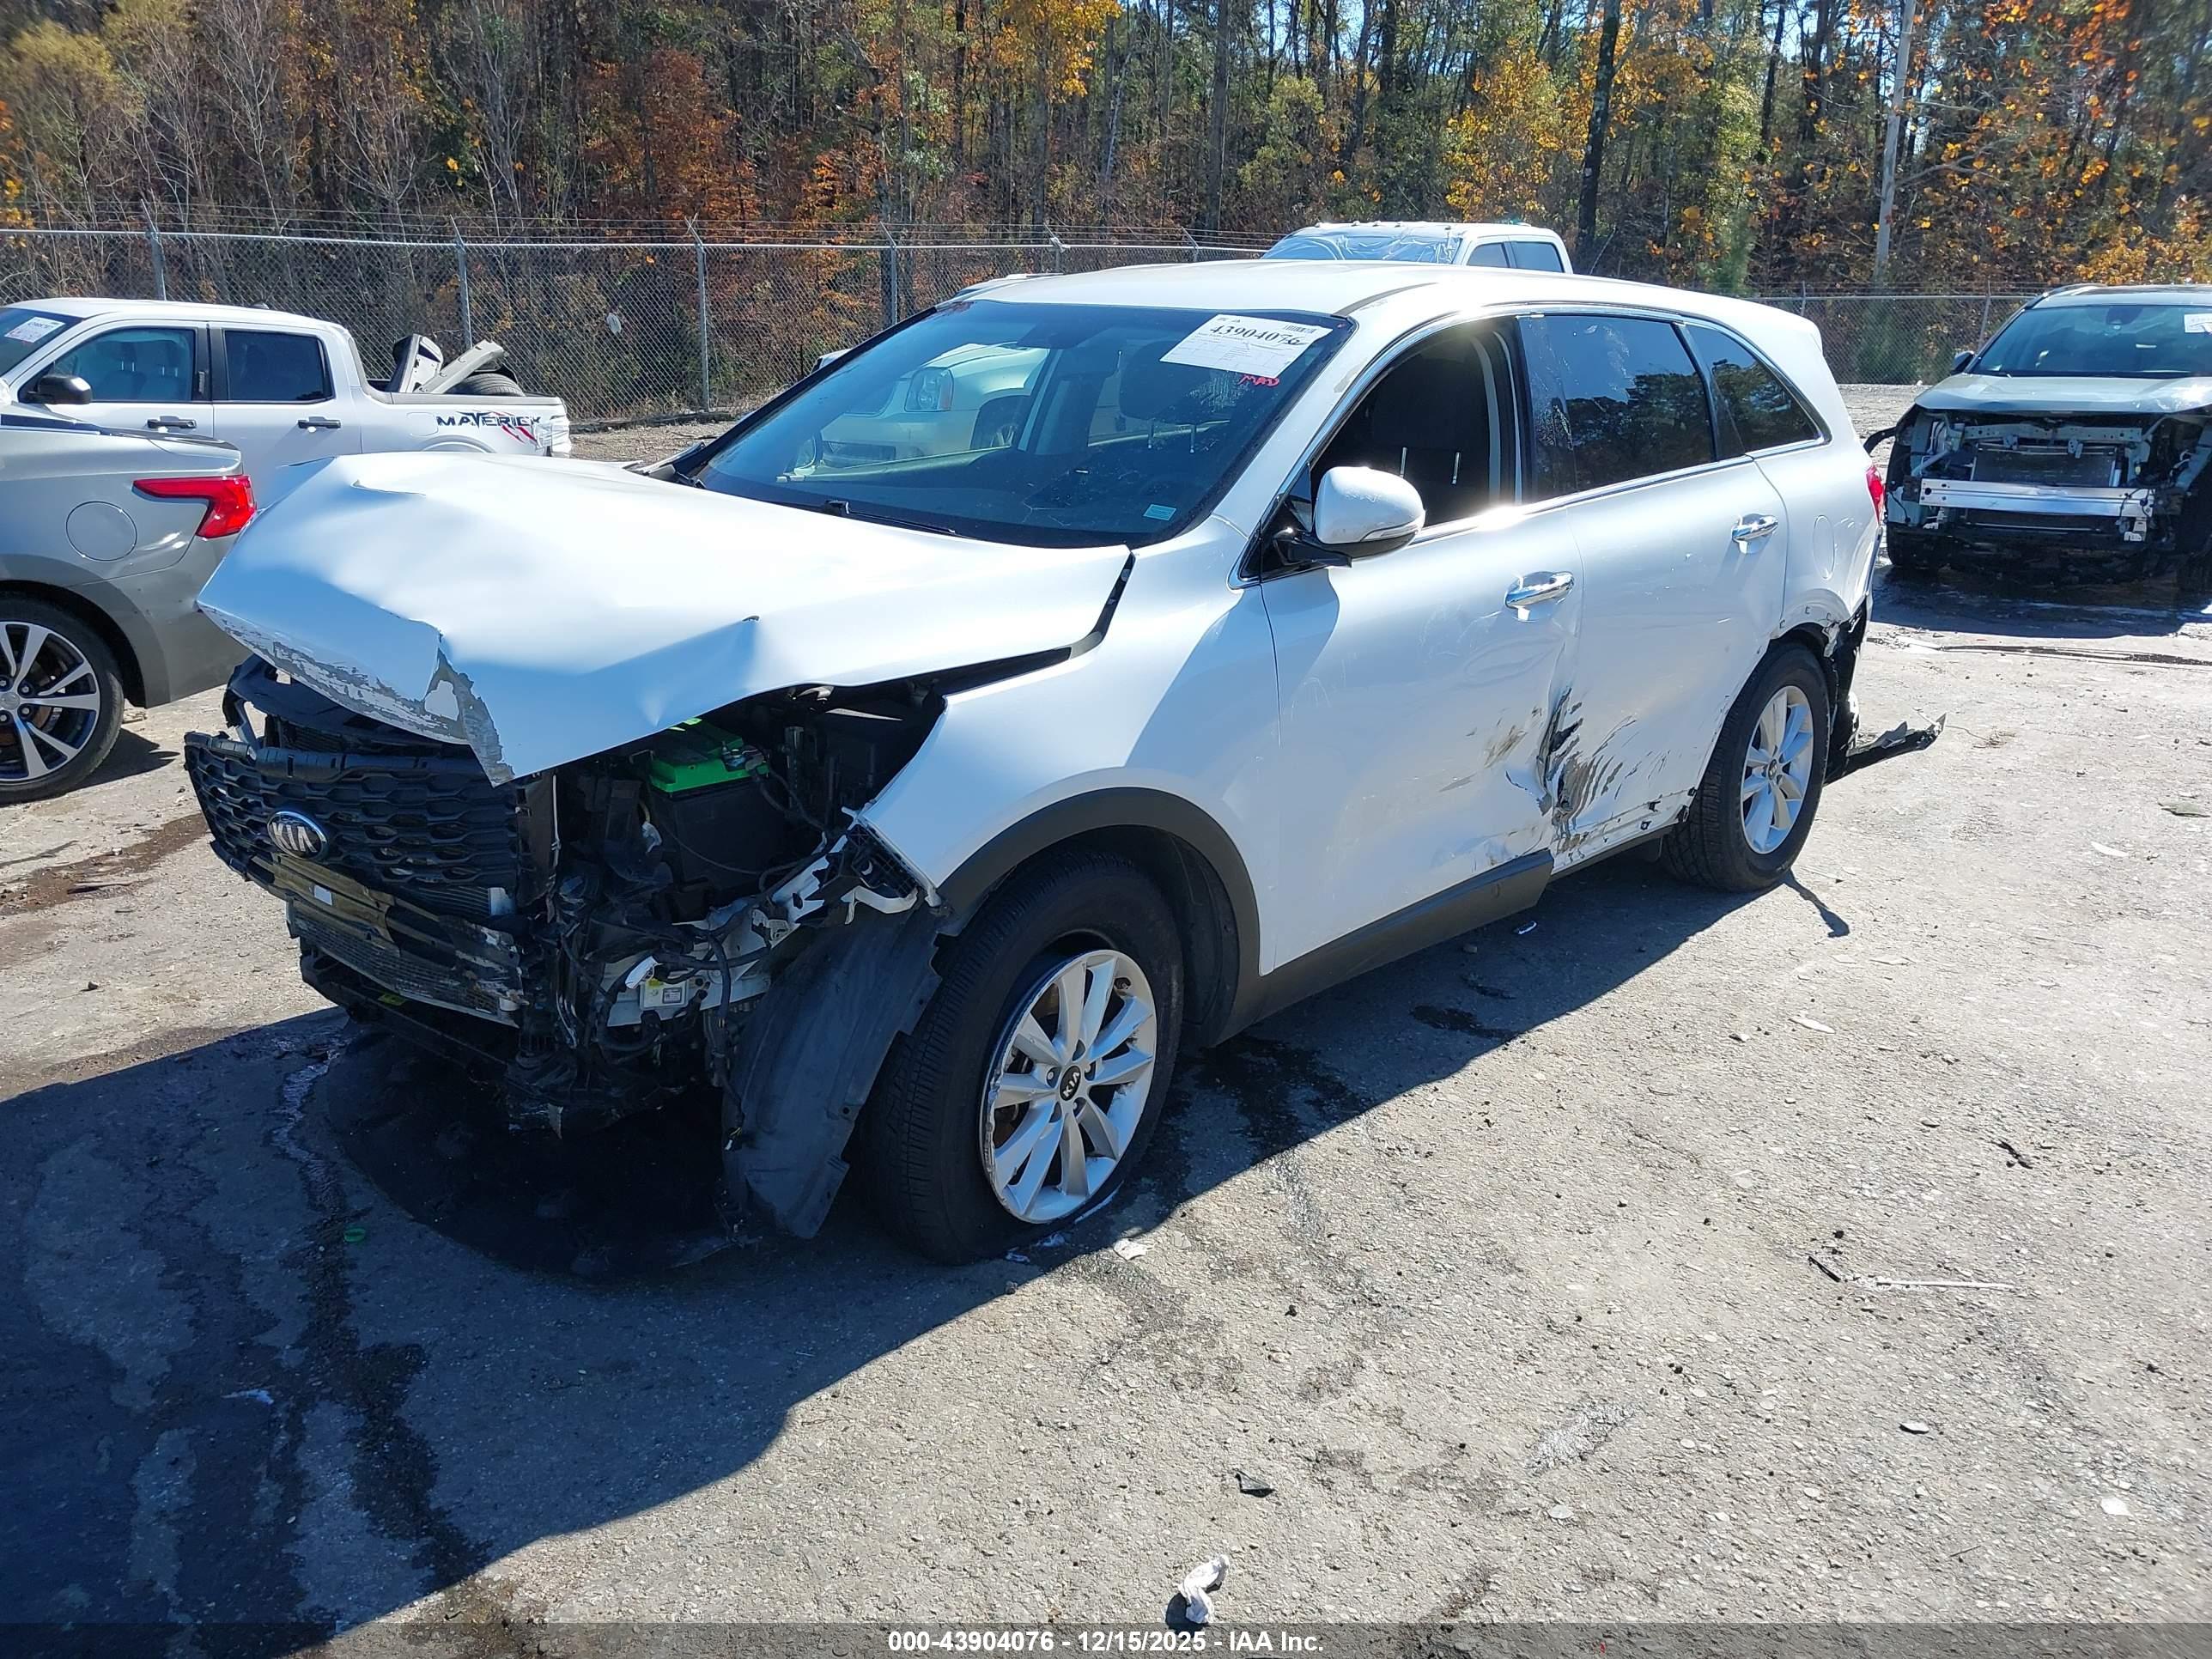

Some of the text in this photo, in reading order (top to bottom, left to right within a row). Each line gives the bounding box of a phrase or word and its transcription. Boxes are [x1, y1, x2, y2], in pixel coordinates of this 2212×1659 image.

[1210, 325, 1304, 345] 43904076
[436, 410, 541, 429] MAVERICK
[271, 822, 318, 853] KIA
[1063, 1072, 1079, 1097] KIA
